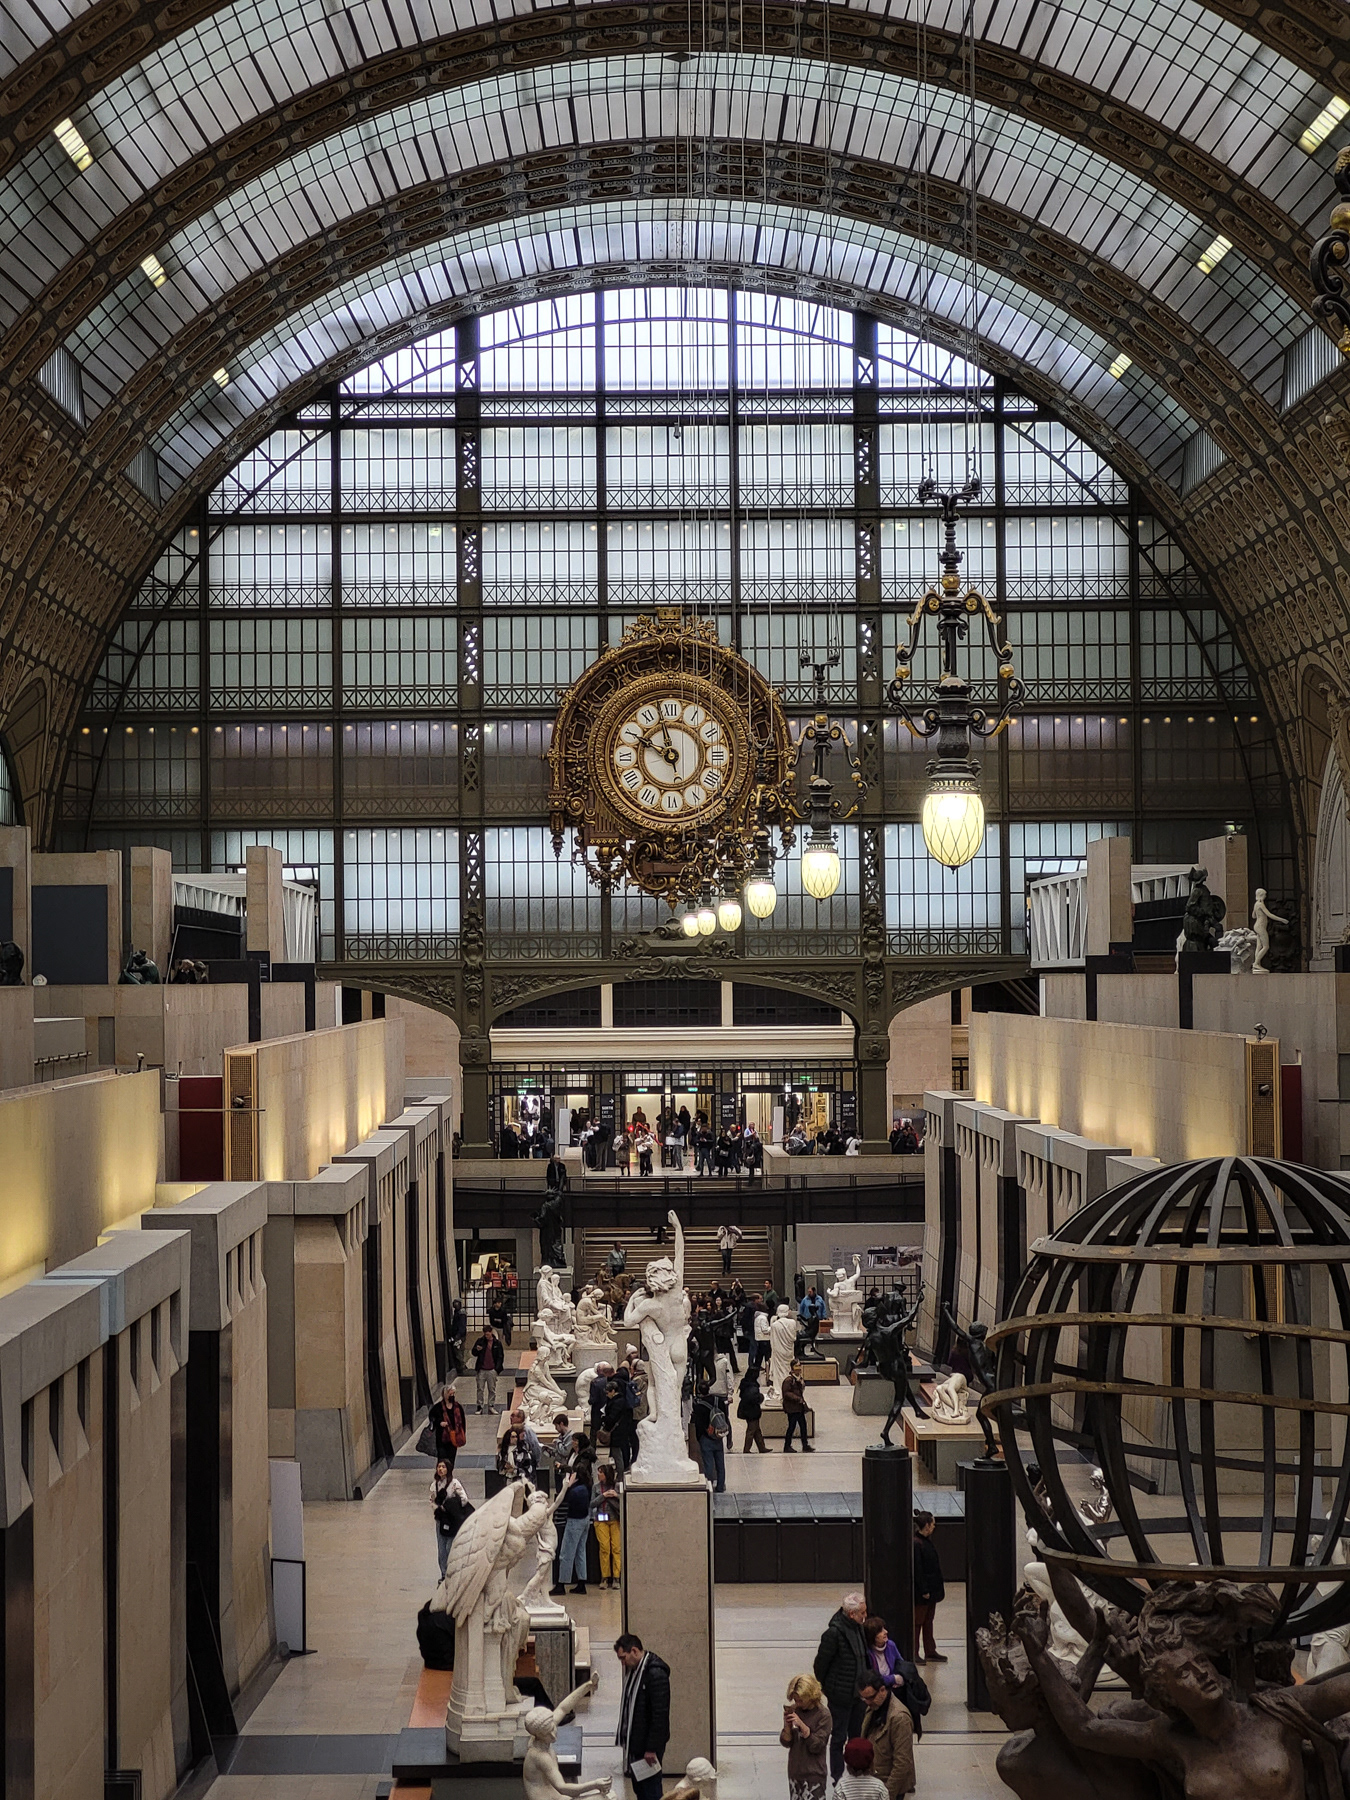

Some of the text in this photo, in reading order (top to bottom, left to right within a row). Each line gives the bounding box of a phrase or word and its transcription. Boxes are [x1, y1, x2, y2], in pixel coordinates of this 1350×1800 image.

[642, 709, 655, 724] XI
[663, 703, 677, 717] XII
[705, 727, 718, 738] II
[619, 751, 632, 762] IX
[712, 751, 724, 761] III
[623, 770, 639, 789] VIII
[703, 770, 720, 788] IIII
[640, 788, 656, 805] VII
[667, 795, 678, 809] VI
